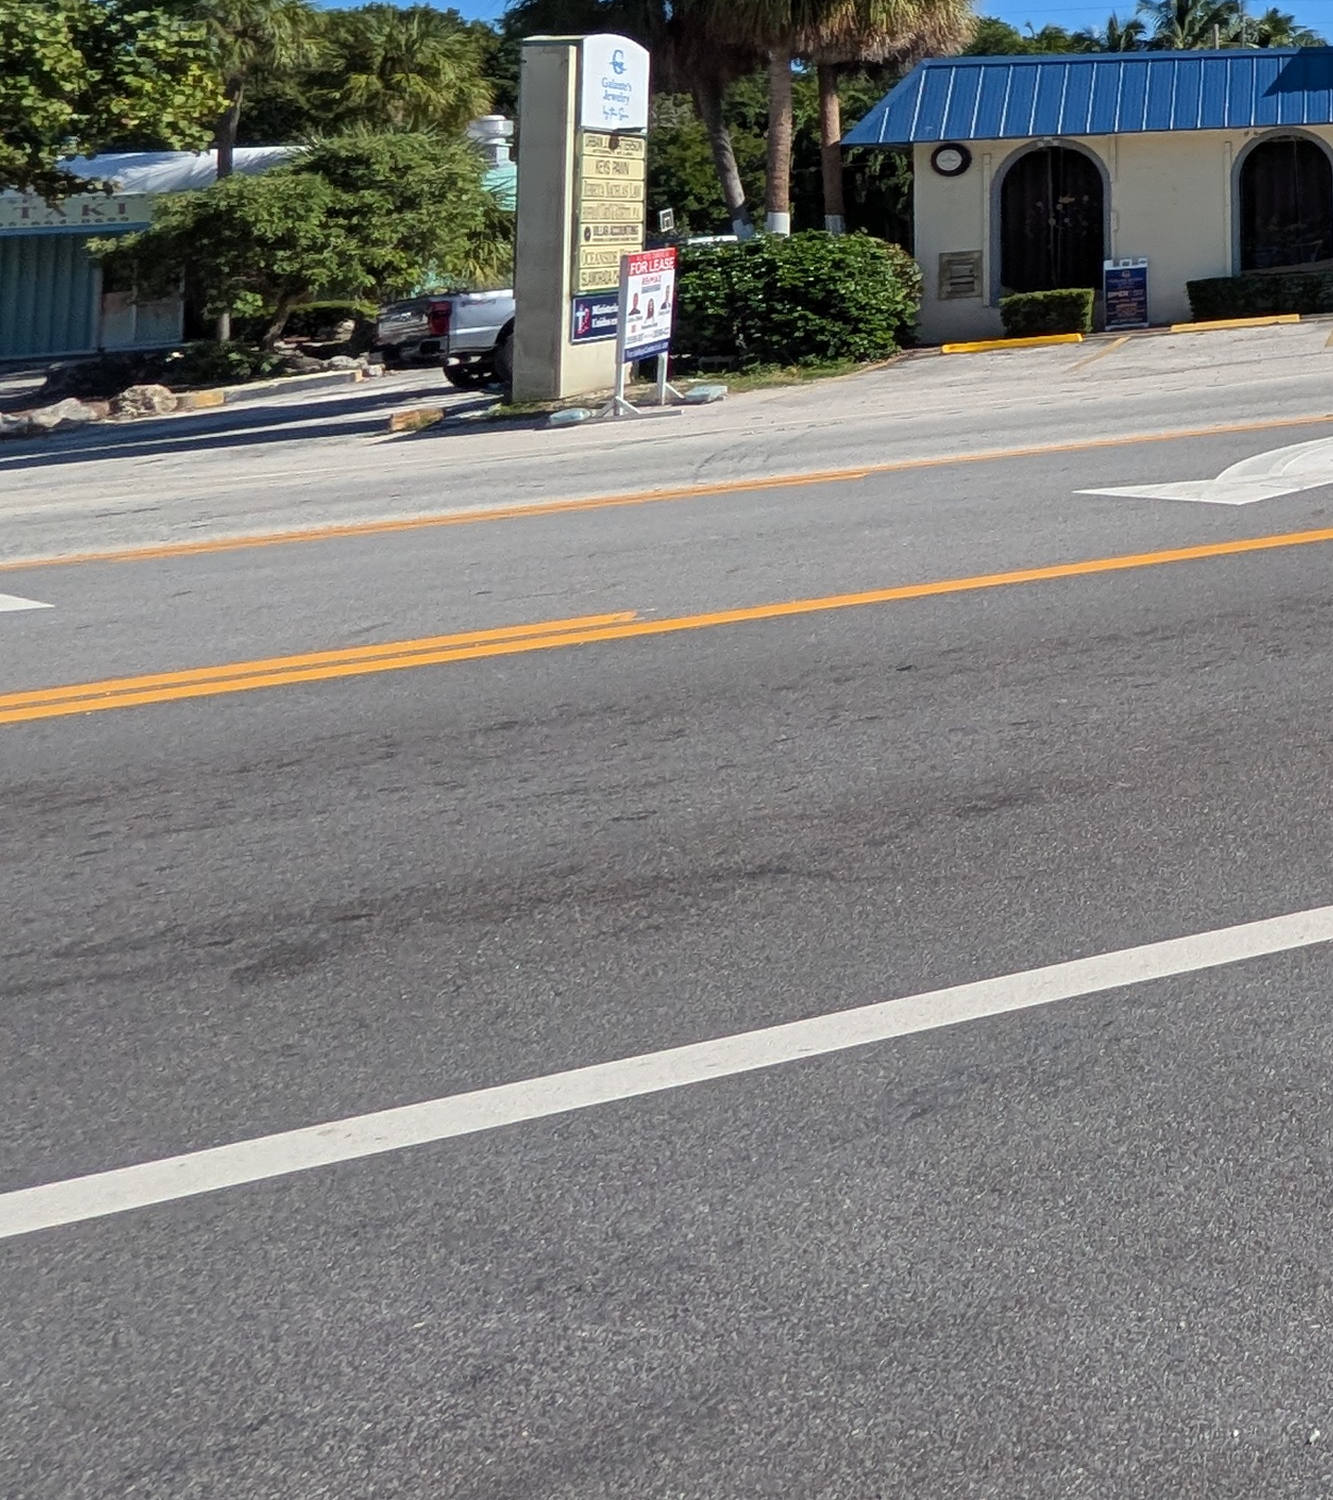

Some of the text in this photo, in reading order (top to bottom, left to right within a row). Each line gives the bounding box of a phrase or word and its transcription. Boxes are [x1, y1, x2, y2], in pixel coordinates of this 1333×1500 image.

[603, 90, 630, 106] Jewelry
[595, 159, 629, 175] KEYS PAWN
[630, 257, 675, 275] FOR LEASE
